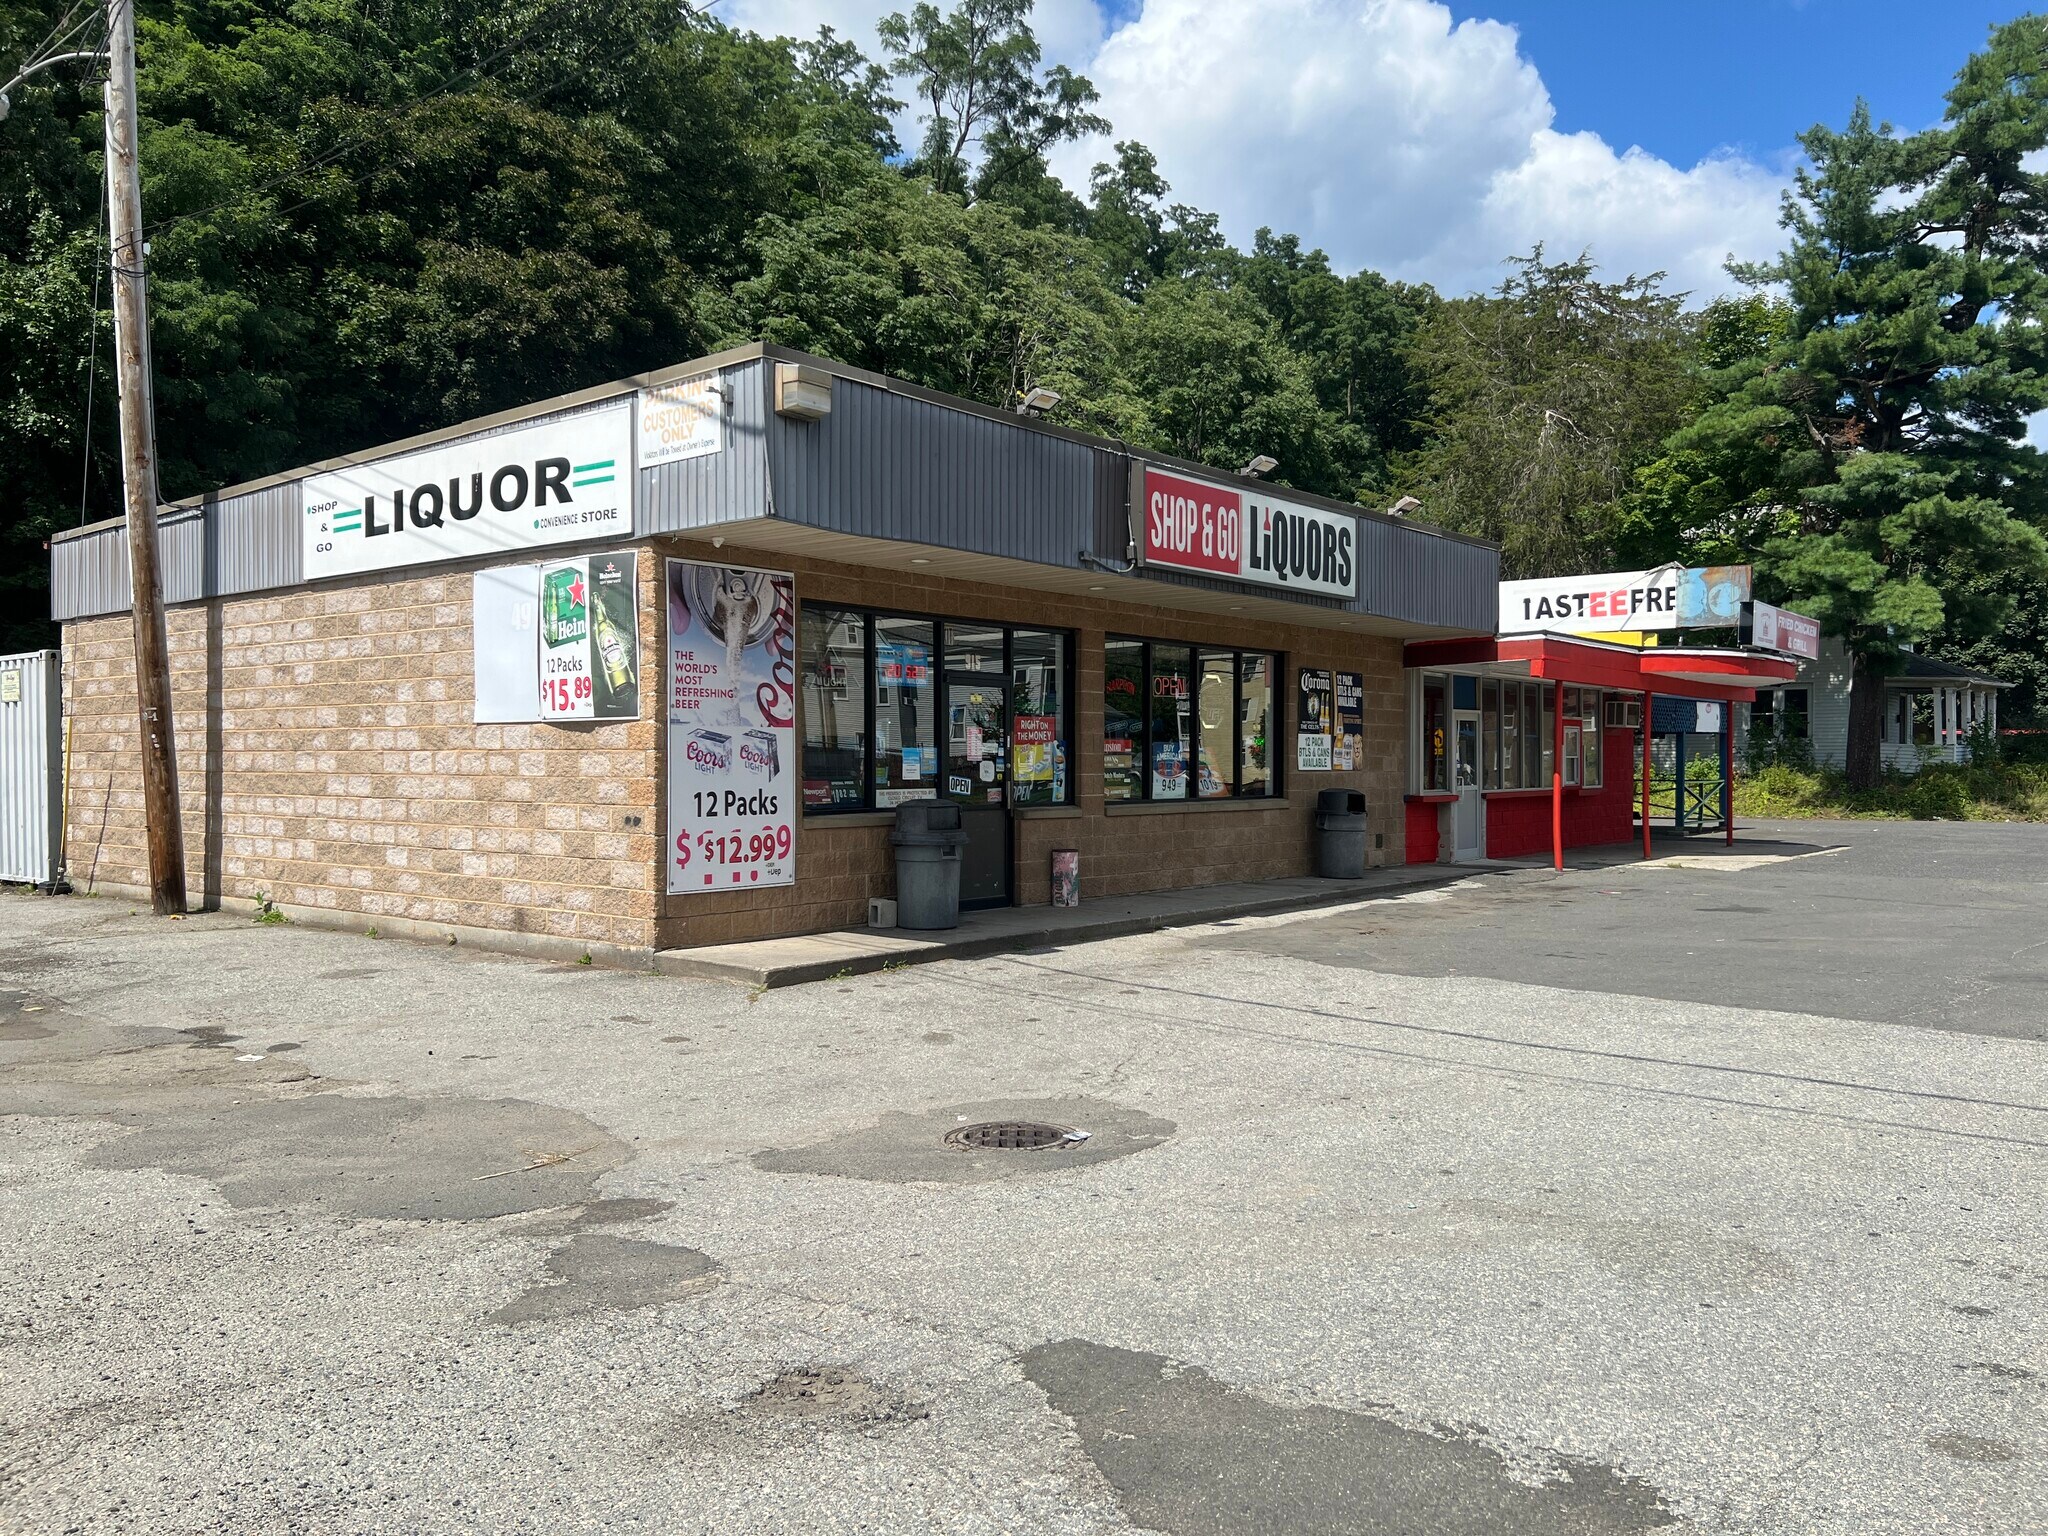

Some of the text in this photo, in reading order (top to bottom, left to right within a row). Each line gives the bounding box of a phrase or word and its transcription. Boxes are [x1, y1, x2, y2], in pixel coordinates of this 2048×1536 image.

[644, 399, 714, 433] CUSTOMERS
[661, 424, 694, 444] ONLY
[365, 457, 573, 538] LIQUOR
[311, 501, 338, 514] SHOP
[540, 508, 618, 529] CONVENIENCE STORE
[320, 523, 328, 532] &
[1151, 491, 1238, 562] SHOP & GO
[316, 542, 333, 553] GO
[1249, 505, 1351, 587] LIQUORS
[1778, 616, 1817, 638] FRIED CHICKEN
[1788, 637, 1793, 649] &
[1793, 638, 1807, 653] GRILL
[675, 650, 693, 661] THE
[547, 656, 582, 673] 12 Packs
[675, 663, 717, 674] WORLD'S
[675, 676, 702, 686] MOST
[1154, 677, 1185, 696] OPEN
[1301, 672, 1330, 693] Corona
[1336, 674, 1342, 685] 12
[1342, 675, 1353, 686] PACK
[676, 687, 734, 699] REFRESHING
[676, 699, 701, 709] BEER
[1020, 719, 1049, 731] RIGHT ON
[1017, 731, 1052, 742] THE MONEY
[1305, 737, 1324, 747] 12 PACK
[687, 741, 724, 769] Coors
[740, 744, 770, 766] Coors
[1163, 744, 1175, 753] BUY
[1299, 747, 1312, 757] BTLS
[1312, 748, 1316, 757] &
[1317, 748, 1330, 758] CANS
[695, 762, 715, 774] LIGHT
[745, 761, 763, 772] LIGHT
[1303, 758, 1328, 768] AVAILABLE
[951, 777, 970, 794] OPEN
[1161, 779, 1177, 792] 949
[694, 788, 777, 818] 12 Packs
